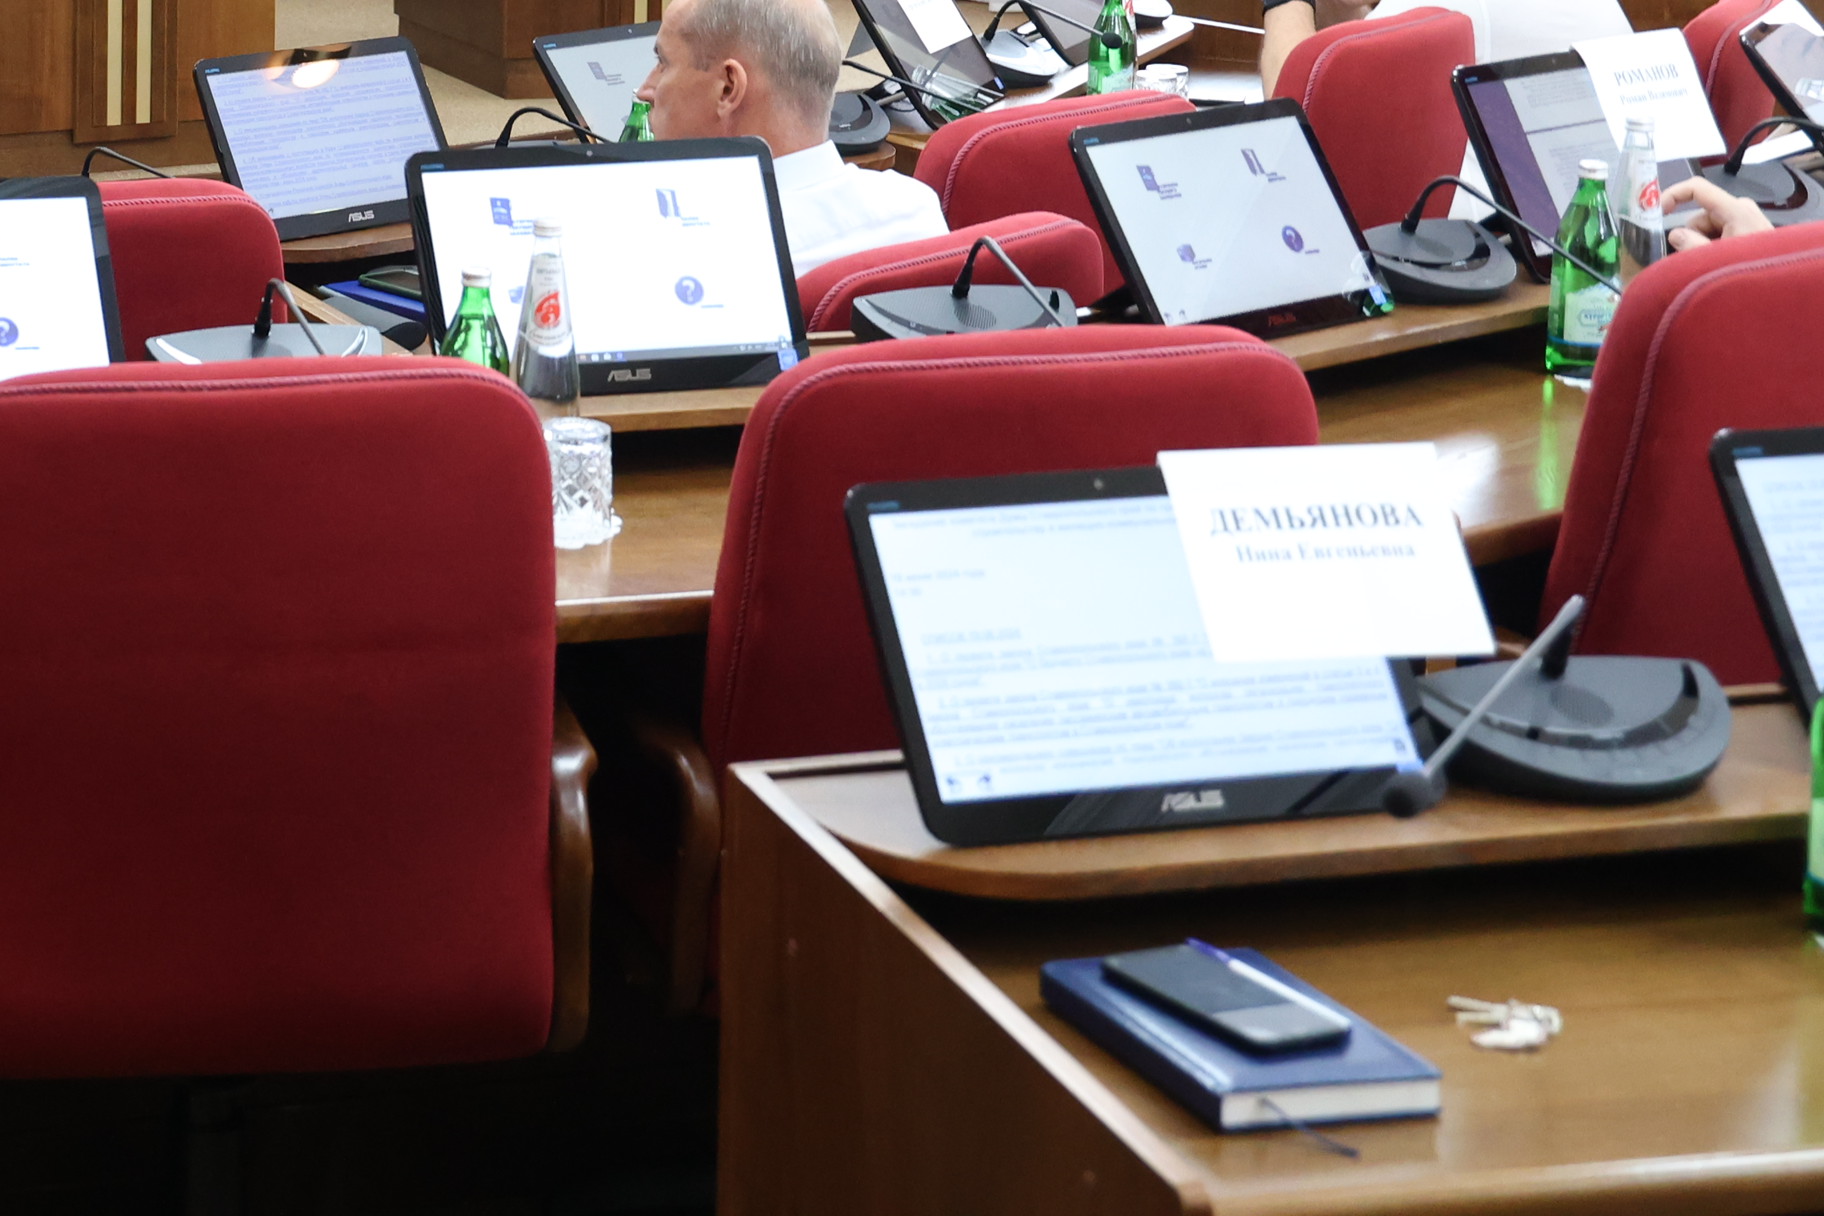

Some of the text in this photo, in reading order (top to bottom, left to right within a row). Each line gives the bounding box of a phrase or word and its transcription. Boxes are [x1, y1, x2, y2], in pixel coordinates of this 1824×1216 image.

[1613, 63, 1679, 87] РОМАНОВ
[348, 209, 375, 223] ASUS
[607, 368, 652, 382] ASUS
[1210, 502, 1424, 537] ДЕМЬЯНОВА
[1236, 541, 1416, 564] Нина Евгеньевна
[1160, 788, 1225, 813] ASUS
